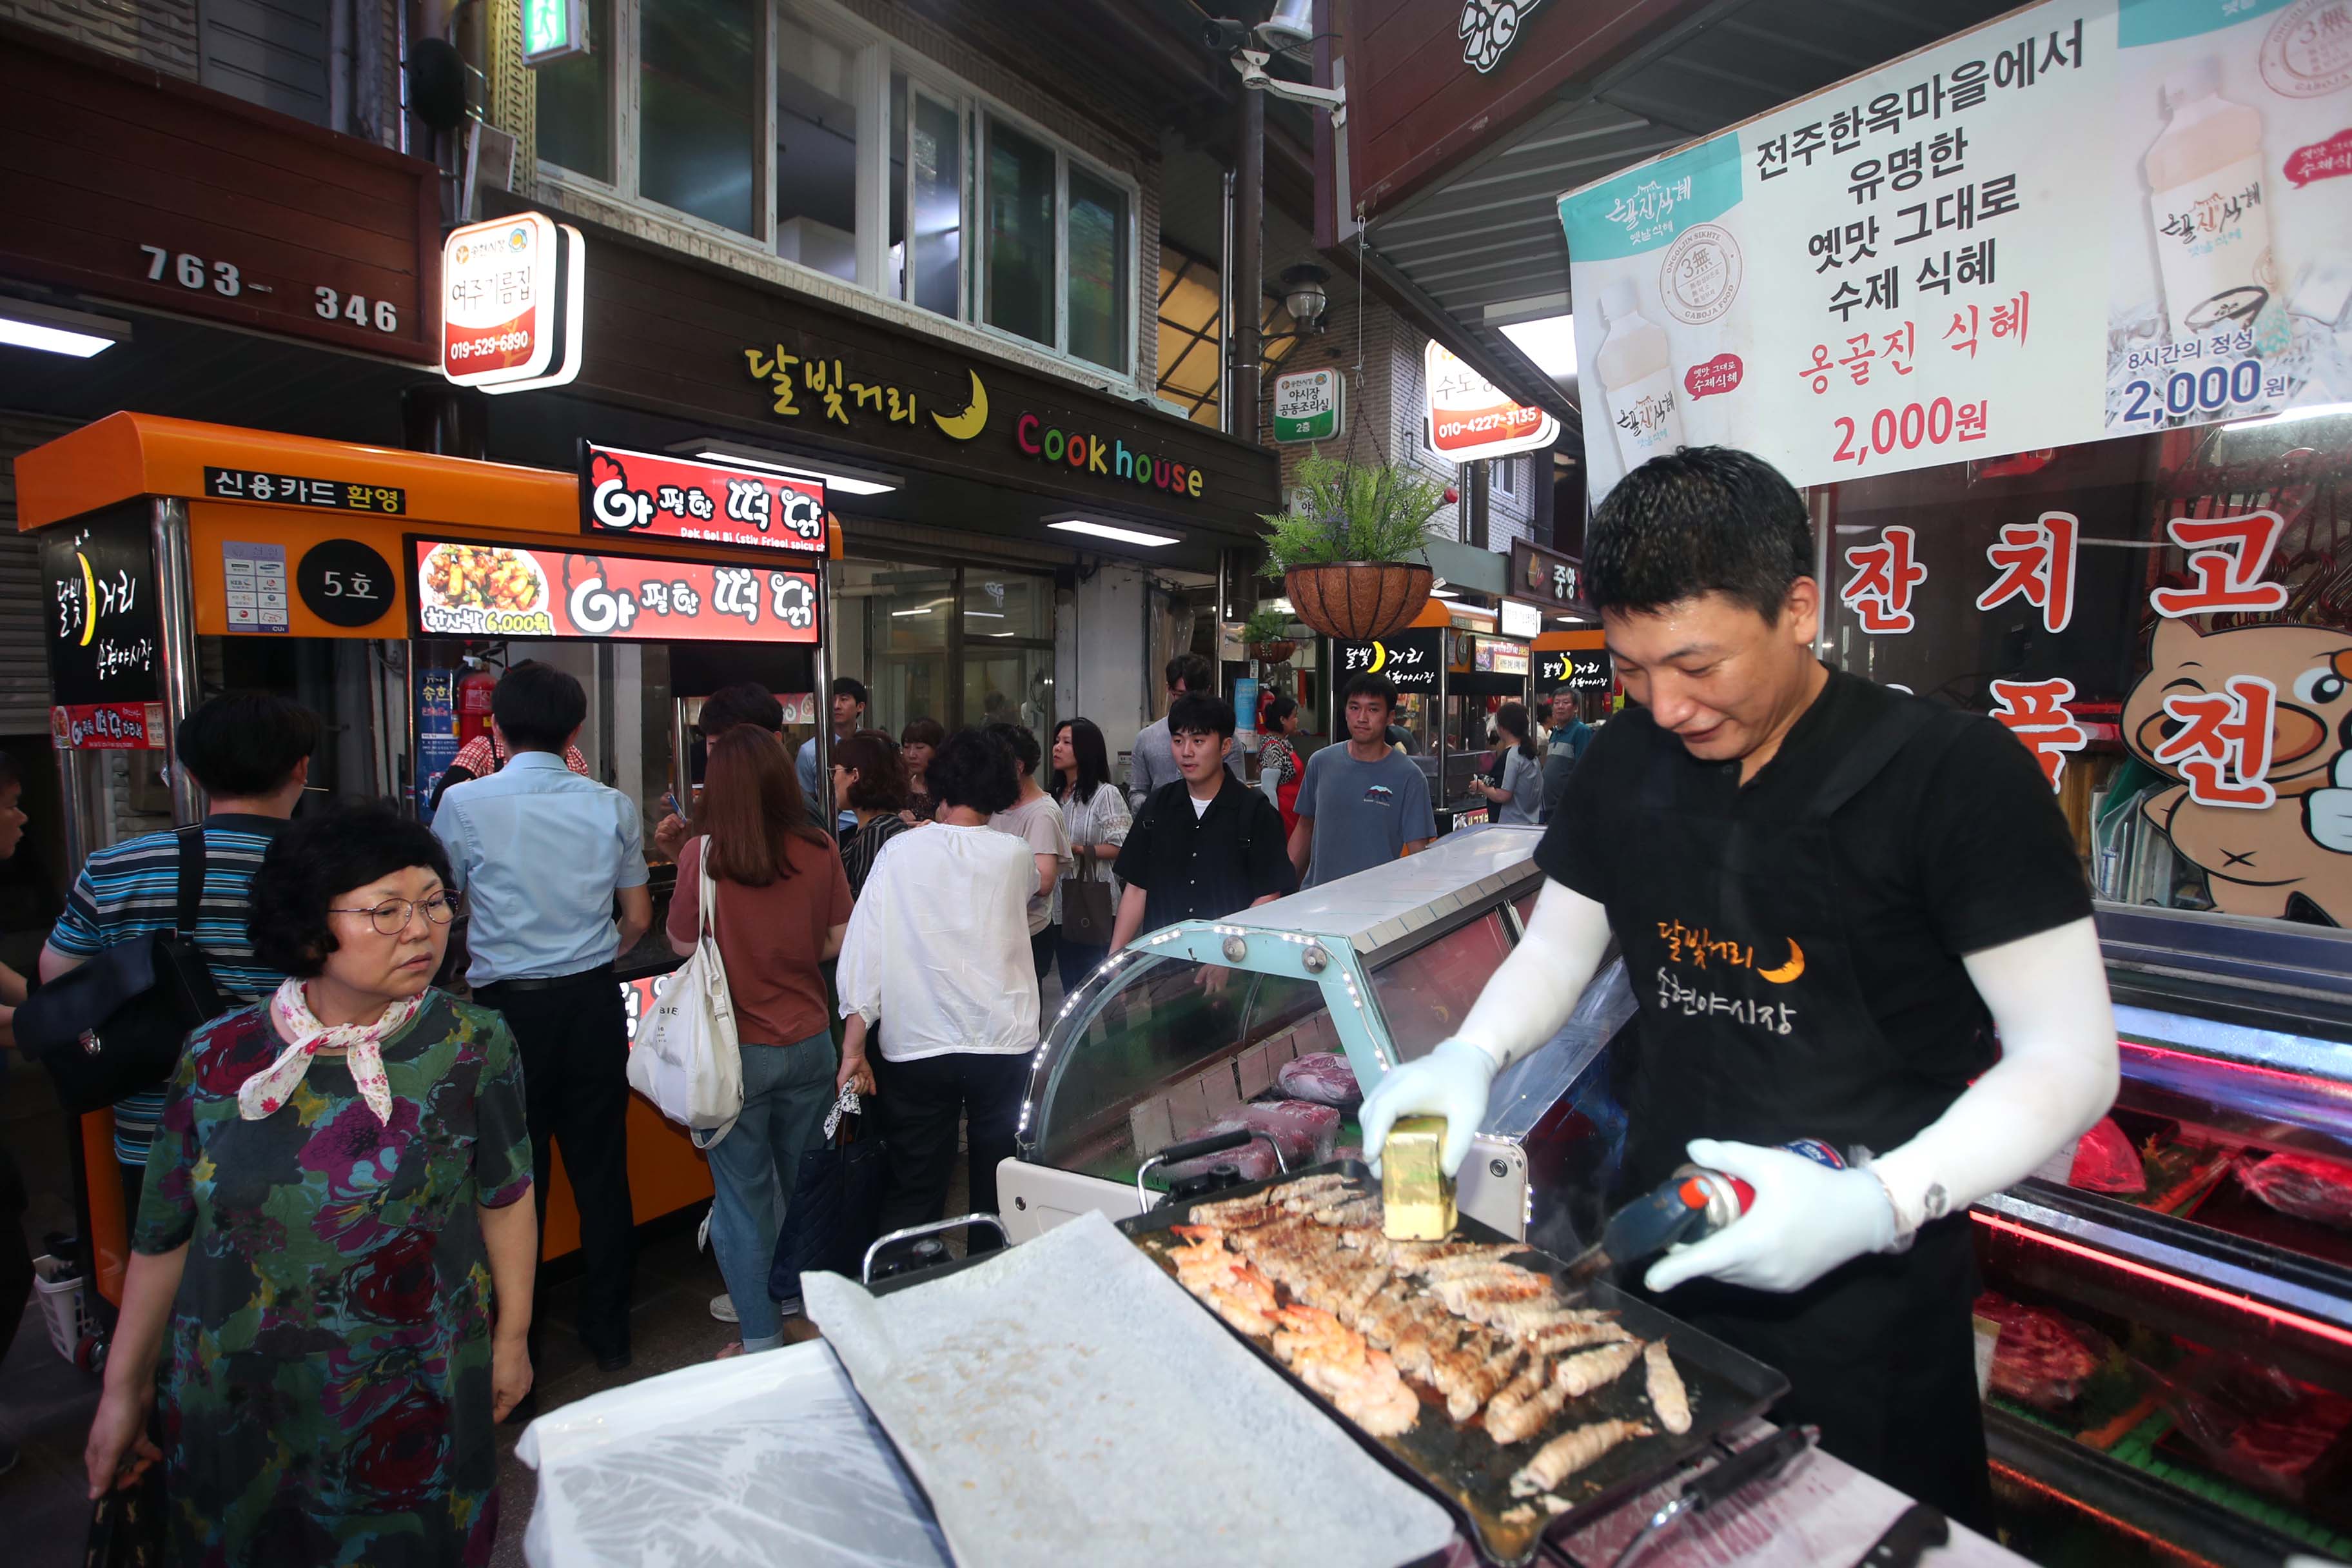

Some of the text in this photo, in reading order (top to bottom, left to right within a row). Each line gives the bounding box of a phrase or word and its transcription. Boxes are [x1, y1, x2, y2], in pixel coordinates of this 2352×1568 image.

[1758, 18, 2083, 182] 전주한옥마을에서
[1848, 127, 1968, 205] 유명한
[1808, 173, 2019, 274] 옛맛 그대로
[452, 266, 531, 311] 여주기름집
[1828, 237, 1995, 322] 수제 식혜
[315, 286, 397, 332] 346
[1685, 284, 1734, 319] GABOJA FOOD
[451, 330, 529, 360] 019-529-6890
[1799, 291, 2029, 394] 옹골진 식혜
[2129, 329, 2253, 369] 8시간의 정성
[744, 344, 917, 426] 달빛거리
[1693, 360, 1736, 378] 옛맛 그대로
[1693, 371, 1738, 392] 수제식혜
[1279, 398, 1329, 416] 공동조리실
[1289, 387, 1320, 401] 야시장
[1296, 421, 1310, 433] 2층
[1438, 407, 1538, 438] 010-4227-3135
[1832, 396, 1988, 466] 2,000원
[215, 471, 398, 513] 신용카드 환영
[323, 571, 378, 600] 5호
[485, 611, 552, 635] 6,000원
[1346, 647, 1424, 670] 달빛 거리
[1658, 919, 1753, 970] 달빛거리
[1657, 966, 1797, 1035] 송현야시장
